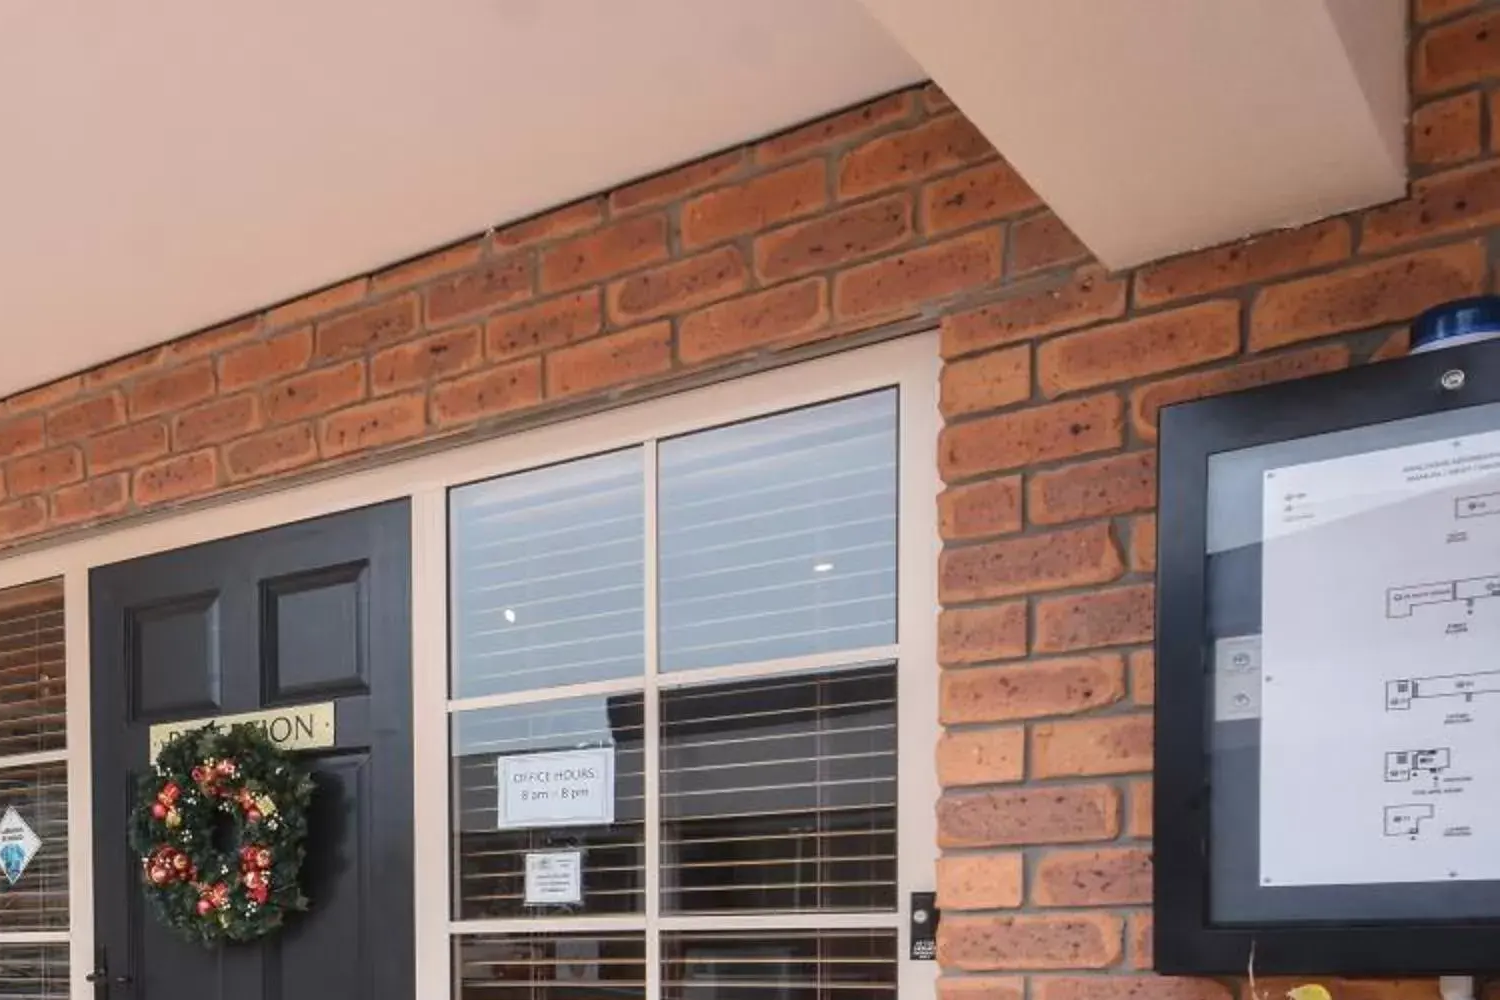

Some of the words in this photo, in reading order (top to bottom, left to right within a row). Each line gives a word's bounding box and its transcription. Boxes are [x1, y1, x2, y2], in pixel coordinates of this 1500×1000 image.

[513, 772, 550, 783] OFFICE
[521, 789, 528, 800] 8
[531, 791, 548, 800] am
[571, 789, 589, 800] pm
